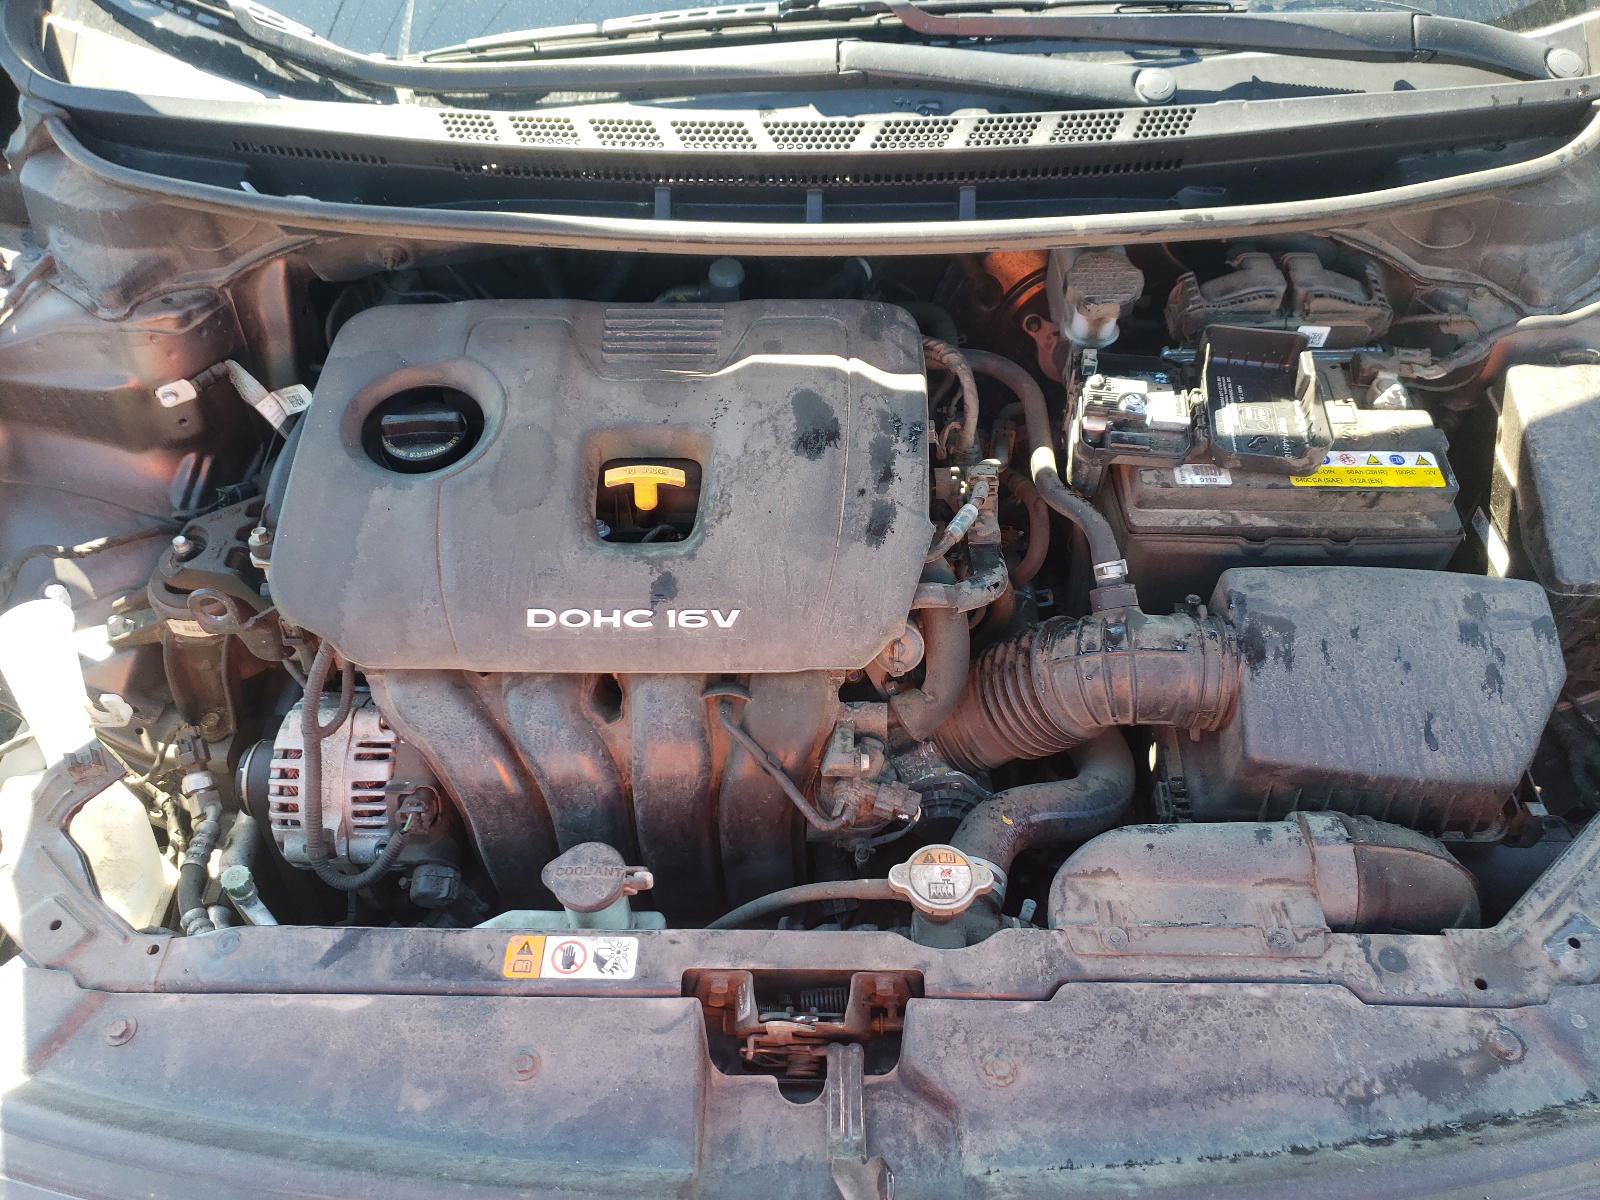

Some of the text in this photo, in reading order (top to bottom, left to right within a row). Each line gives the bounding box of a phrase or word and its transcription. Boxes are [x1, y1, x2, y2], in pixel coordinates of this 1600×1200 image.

[409, 446, 446, 458] OWNER'S
[526, 608, 741, 629] DOHC 16V
[556, 865, 623, 878] COOLANT
